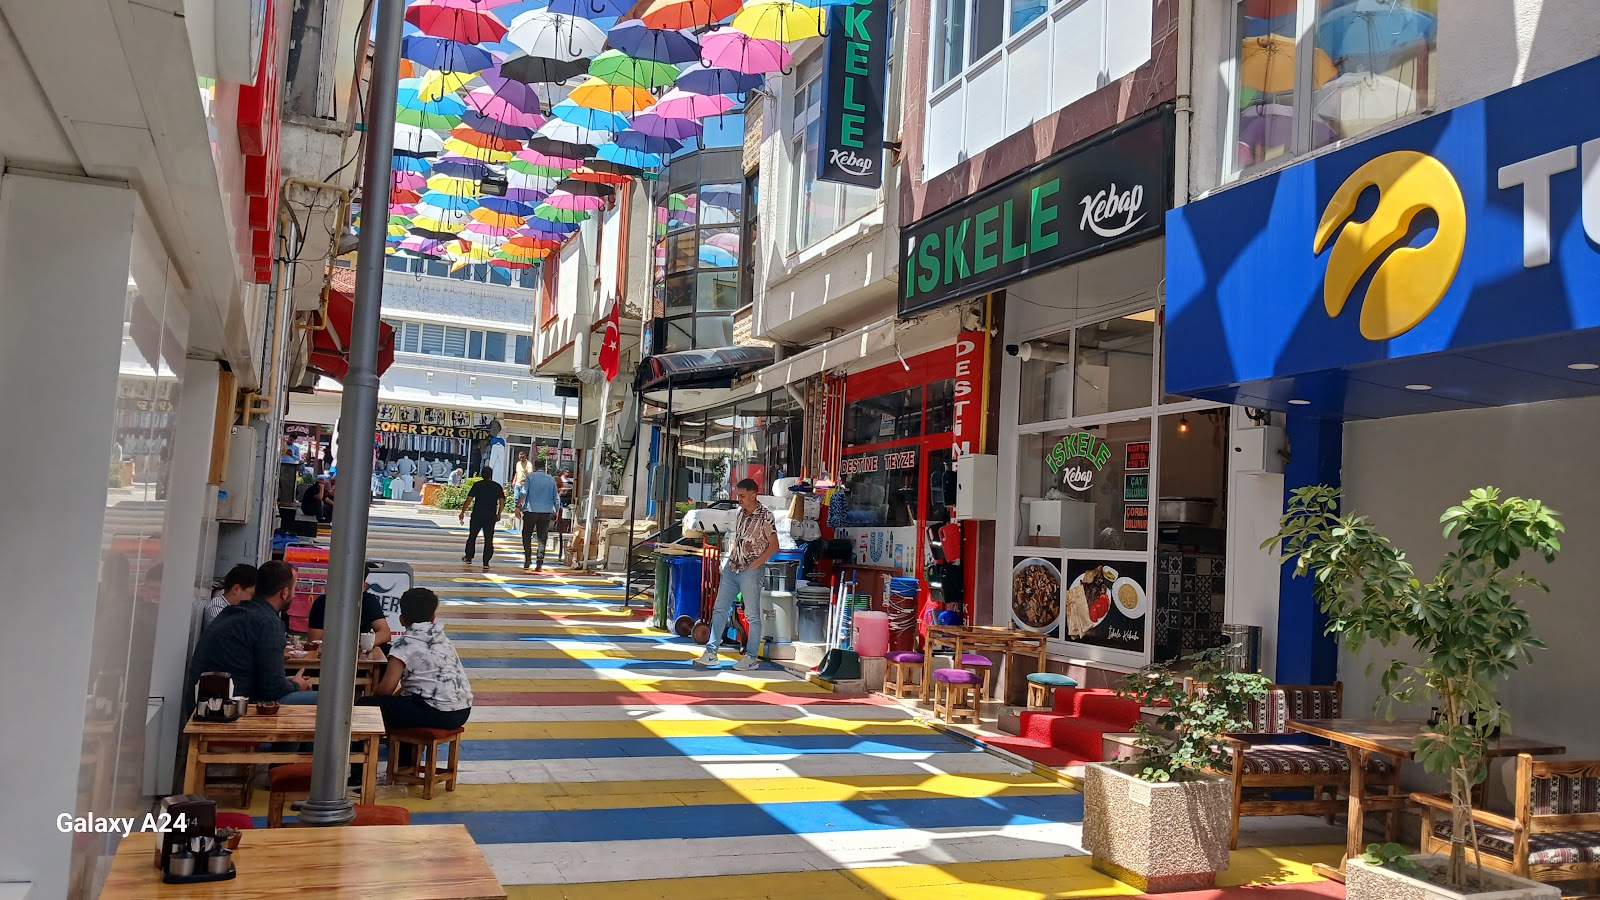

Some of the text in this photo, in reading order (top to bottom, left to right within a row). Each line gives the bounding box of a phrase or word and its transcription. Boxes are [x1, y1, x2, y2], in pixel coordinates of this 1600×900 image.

[841, 0, 873, 148] KELE
[829, 149, 874, 176] Kebap
[1498, 137, 1600, 268] T
[906, 178, 1148, 299] İSKELE Kebap
[375, 421, 418, 434] SONER
[421, 426, 454, 437] SPOR
[841, 450, 915, 475] DESTİNE TEYZE
[1045, 432, 1112, 474] İSKELE
[1063, 465, 1094, 492] Kebap
[1130, 477, 1144, 488] ÇAY
[1126, 507, 1148, 518] ÇORBA
